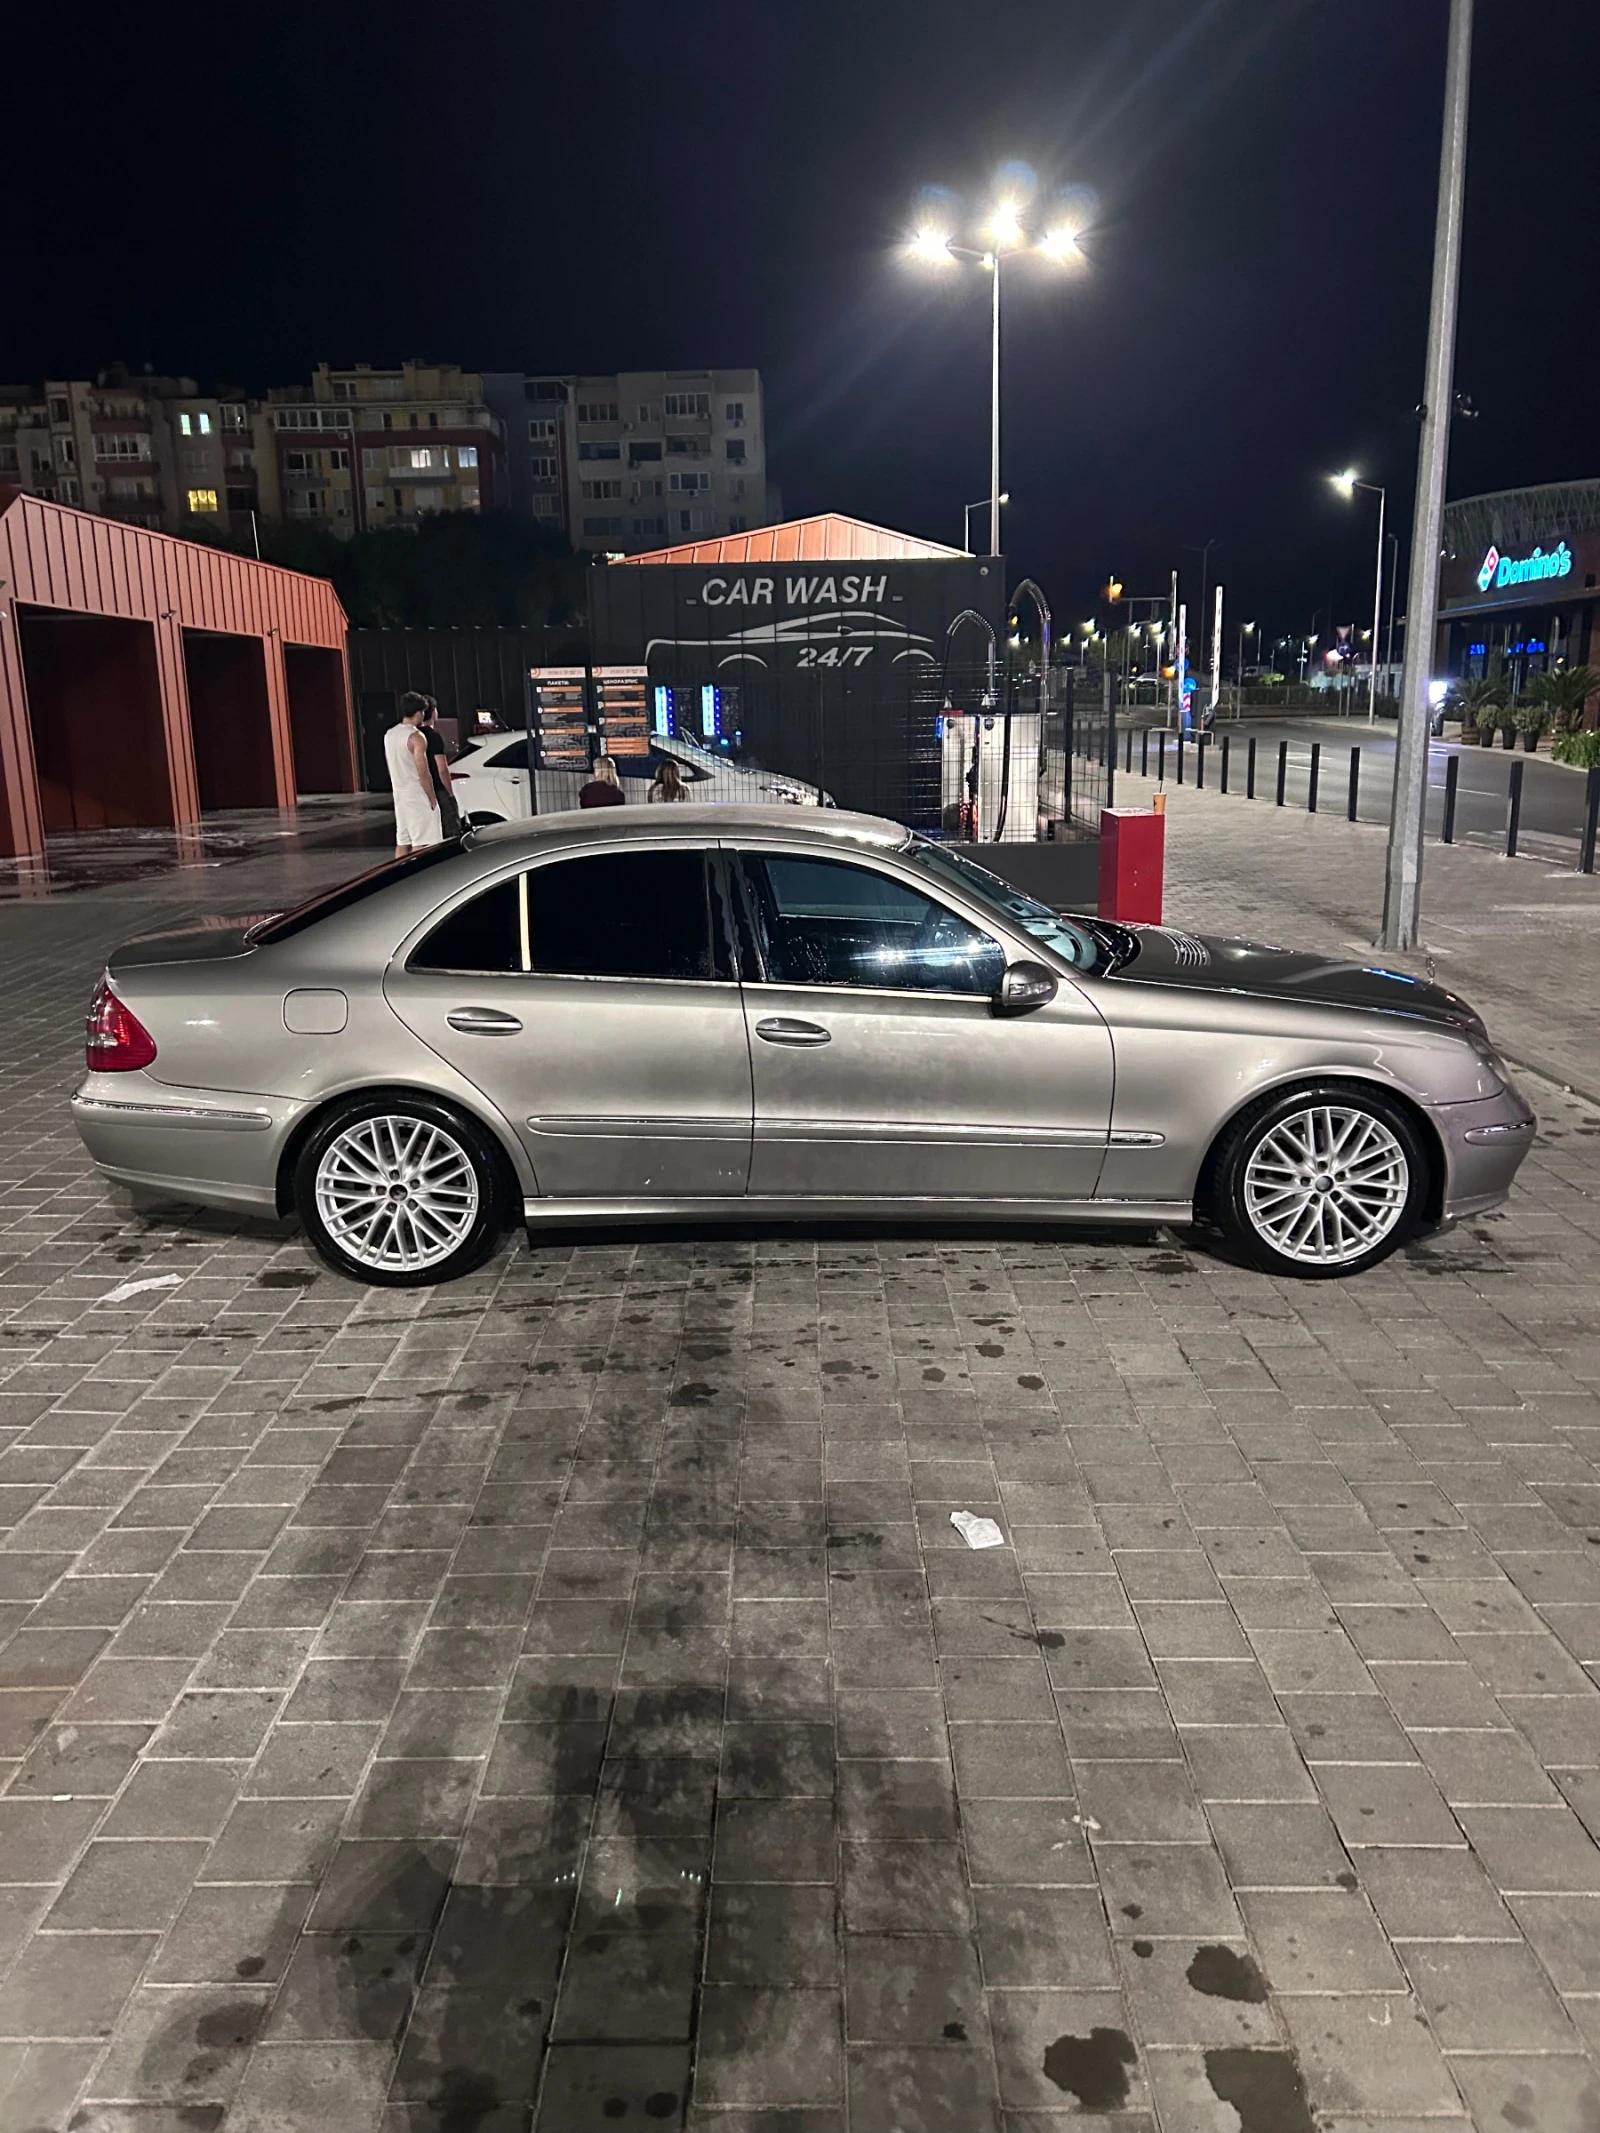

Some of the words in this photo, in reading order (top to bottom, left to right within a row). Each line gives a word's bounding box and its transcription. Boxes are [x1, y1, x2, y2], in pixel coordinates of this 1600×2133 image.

[1497, 541, 1572, 588] Domino's
[702, 578, 774, 605] CAR
[786, 575, 887, 604] WASH
[796, 646, 874, 667] 24/7
